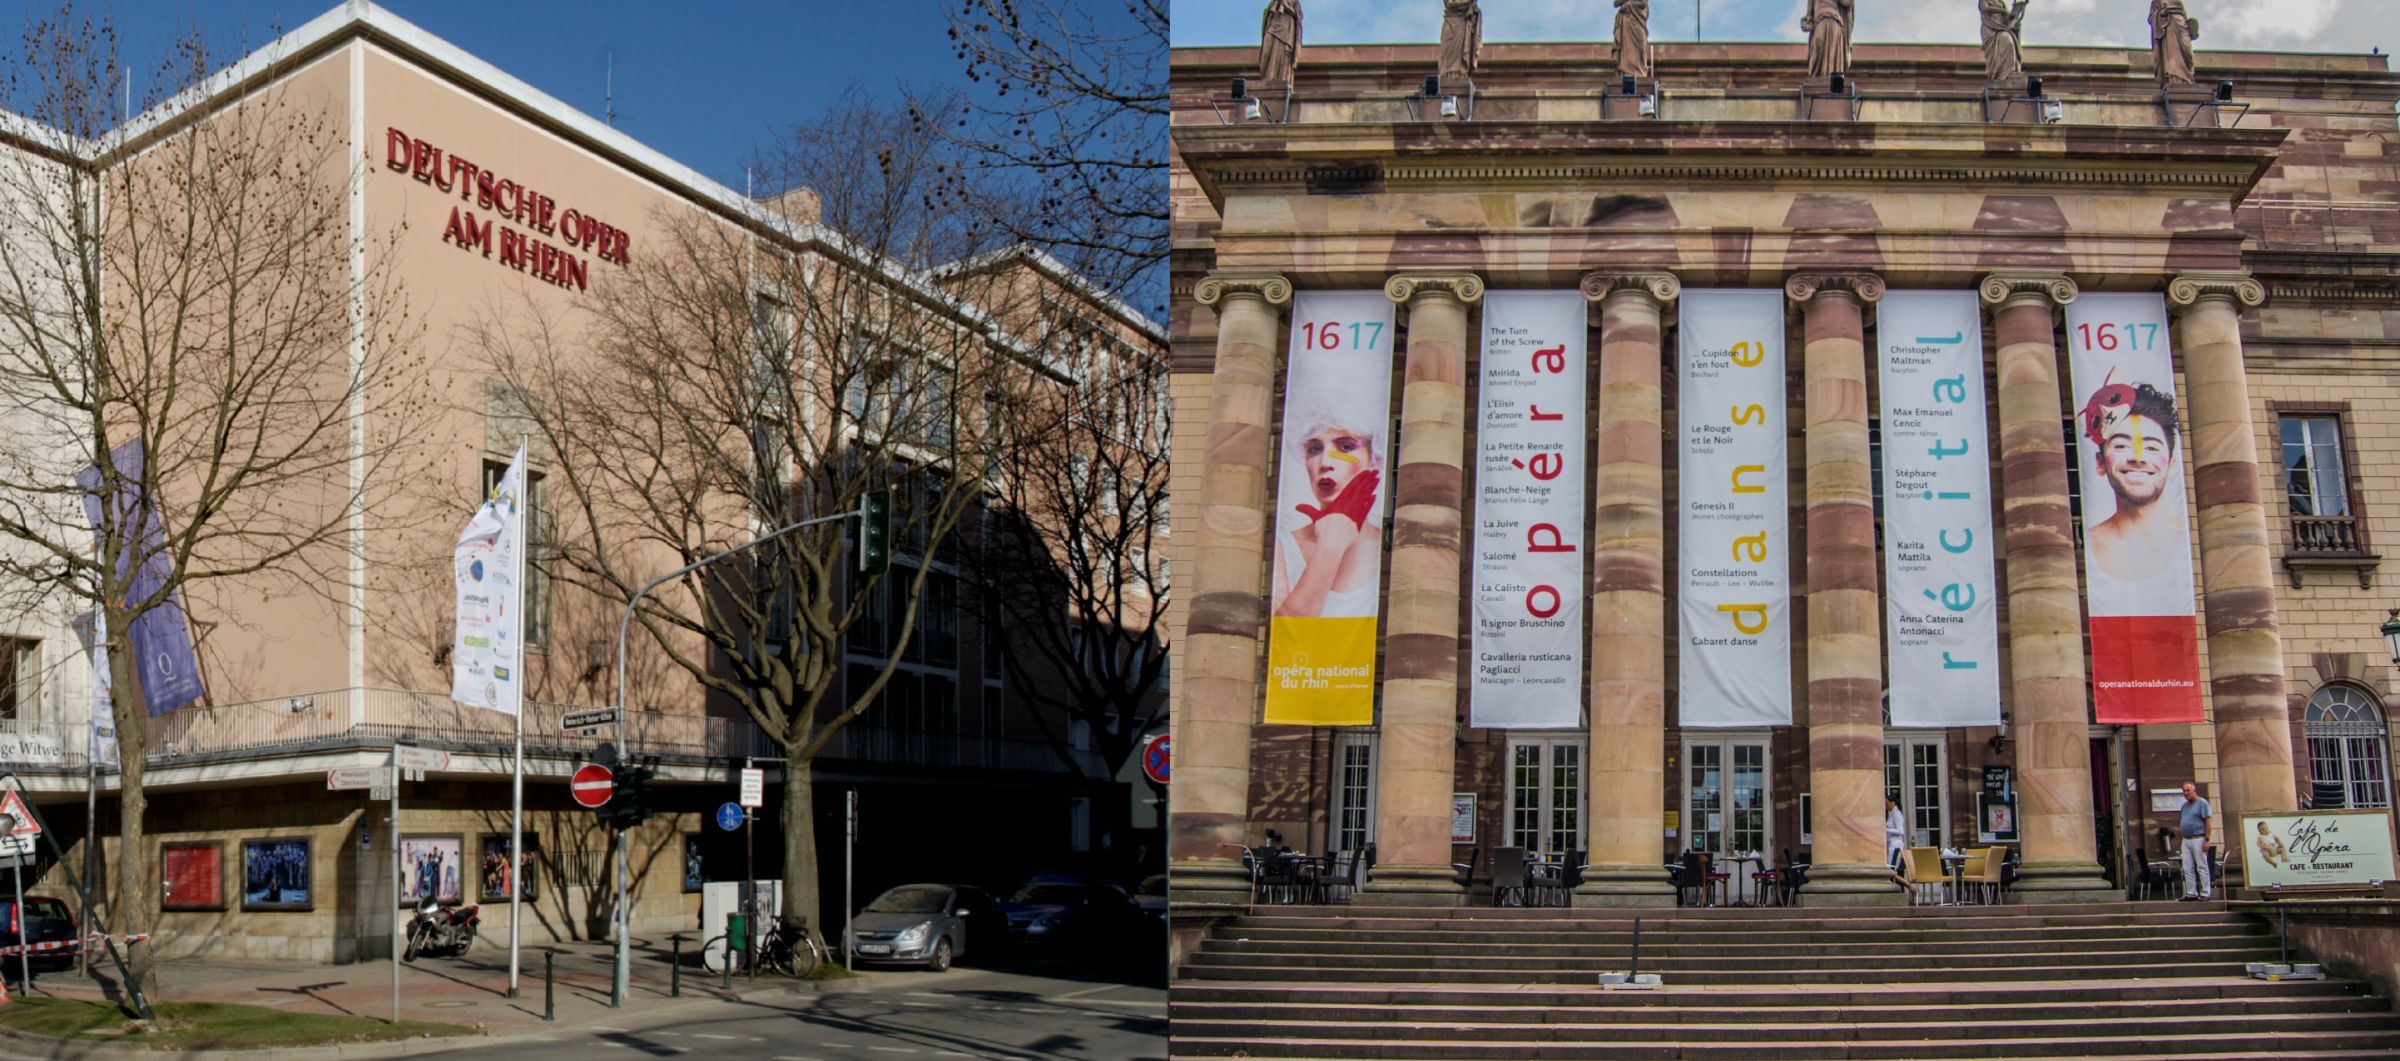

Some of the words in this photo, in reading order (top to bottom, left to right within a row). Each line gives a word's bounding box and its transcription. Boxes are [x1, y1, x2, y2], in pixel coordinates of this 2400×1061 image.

[385, 126, 557, 236] DEUTSCHE
[560, 207, 631, 267] OPER
[443, 205, 494, 258] AM
[499, 225, 588, 293] RHEIN
[1302, 322, 1340, 350] 16
[1348, 322, 1384, 350] 17
[2078, 323, 2118, 351] 16
[2124, 323, 2158, 351] 17
[1490, 338, 1499, 346] of
[1502, 338, 1516, 346] the
[1518, 338, 1544, 346] Screw
[1702, 349, 1739, 358] Cupidon
[1890, 346, 1941, 355] Christopher
[1891, 357, 1931, 365] Maltman
[1488, 400, 1515, 408] L'Elisir
[1487, 412, 1523, 420] d'amore
[1704, 425, 1731, 434] Rouge
[1703, 436, 1711, 444] le
[1714, 436, 1733, 444] Noir
[1895, 469, 1936, 478] Stéphane
[1511, 344, 1576, 618] opéra
[1895, 481, 1928, 490] Degout
[1716, 342, 1768, 635] danse
[1915, 331, 1977, 669] récital
[1691, 502, 1726, 510] Genesis
[1729, 502, 1734, 510] II
[1717, 513, 1763, 521] chorégraphes
[1483, 552, 1516, 560] Salomé
[1898, 553, 1931, 561] Mattila
[1691, 569, 1758, 577] Constellations
[1495, 584, 1526, 592] Calisto
[1900, 615, 1923, 623] Anna
[1926, 615, 1963, 623] Caterina
[1489, 620, 1518, 629] signor
[1692, 637, 1727, 646] Cabaret
[1730, 637, 1758, 646] danse
[1480, 653, 1526, 661] Cavalleria
[1530, 653, 1571, 661] rusticana
[1273, 664, 1313, 680] opéra
[1316, 664, 1369, 676] national
[1480, 665, 1521, 676] Pagliacci
[1281, 676, 1298, 688] du
[1301, 678, 1328, 688] rhin
[1480, 677, 1514, 685] Mascagni
[2100, 680, 2194, 689] operanationaldurhin.eu
[19, 740, 60, 756] Witwe
[2288, 818, 2317, 841] Café
[2325, 820, 2339, 832] de
[2312, 862, 2353, 870] RESTAURANT
